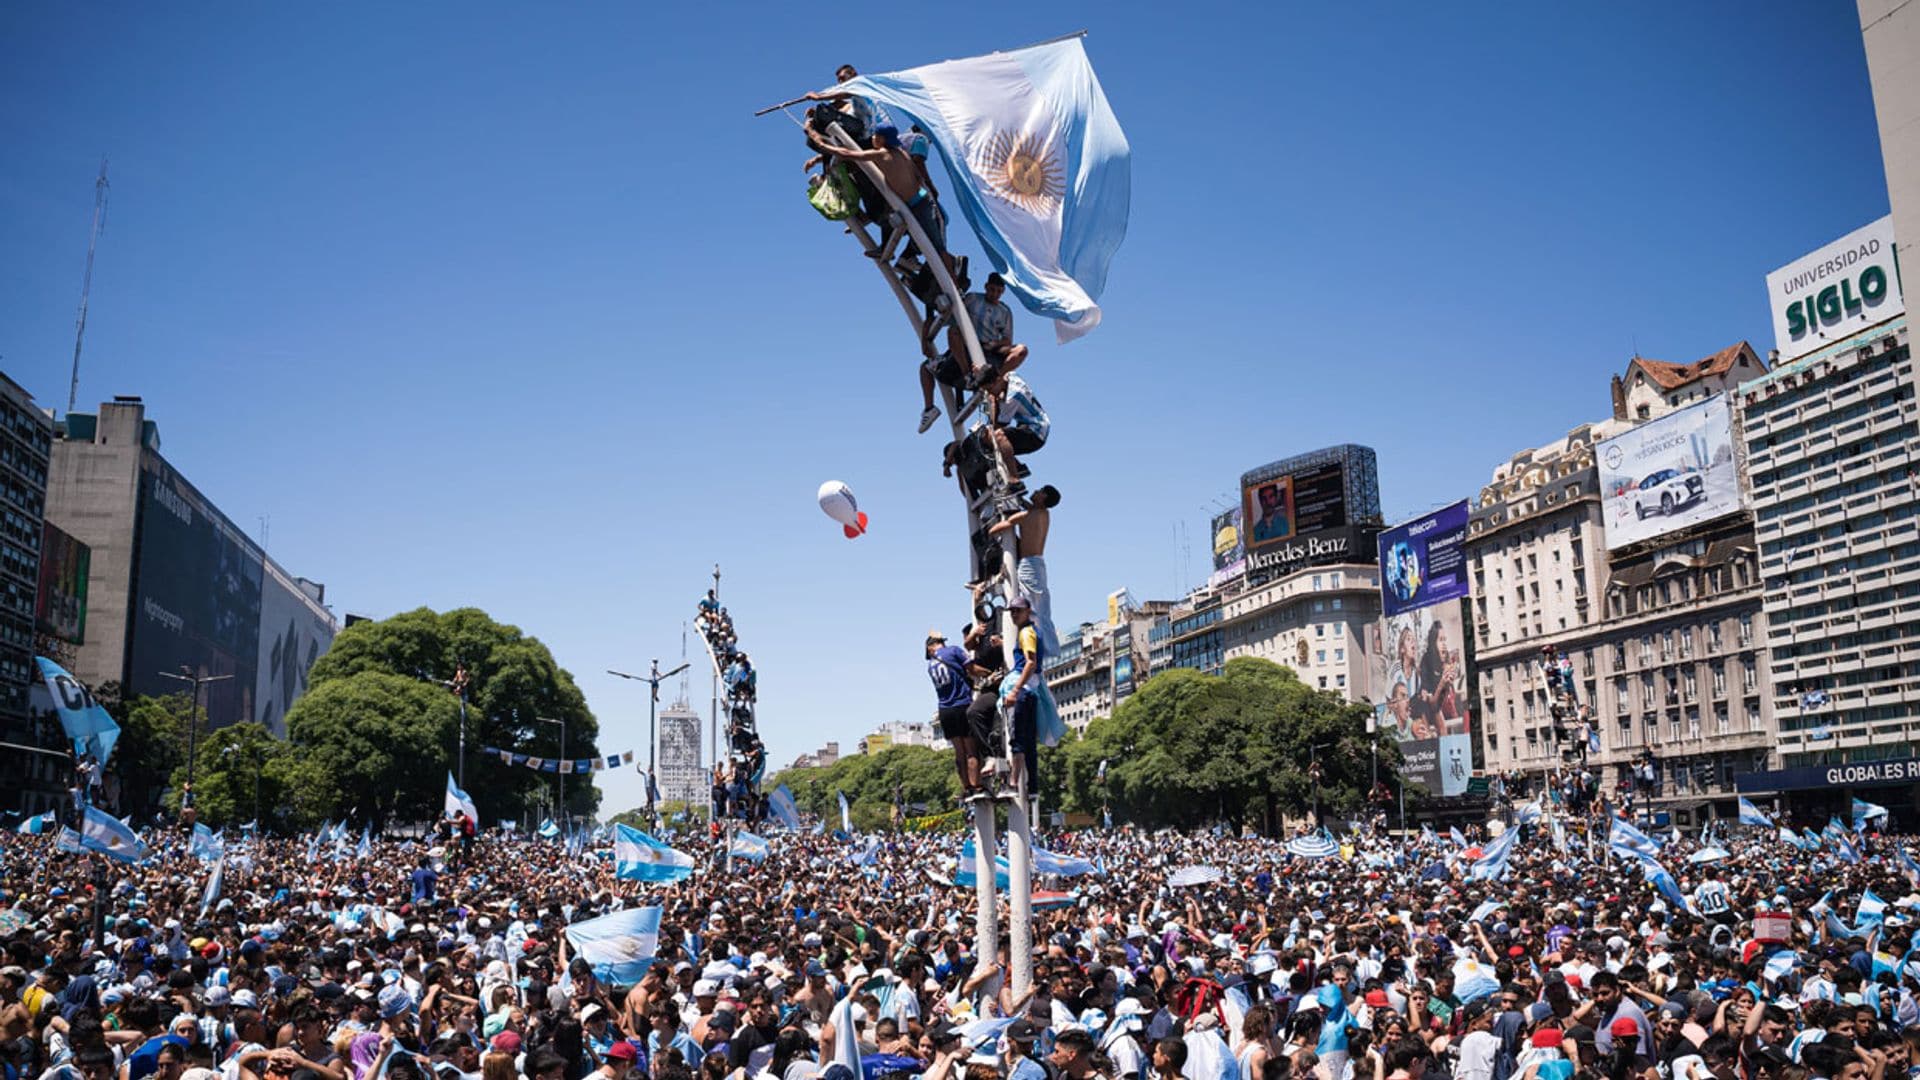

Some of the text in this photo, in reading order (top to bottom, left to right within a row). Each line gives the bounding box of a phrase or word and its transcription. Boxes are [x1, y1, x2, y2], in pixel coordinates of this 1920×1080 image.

[1783, 239, 1880, 295] UNIVERSIDAD
[1786, 265, 1887, 336] SIGLO
[153, 479, 192, 526] SAMSUNG
[1247, 536, 1348, 570] Mercedes-Benz
[1827, 763, 1904, 784] GLOBALES
[1703, 891, 1724, 911] 10
